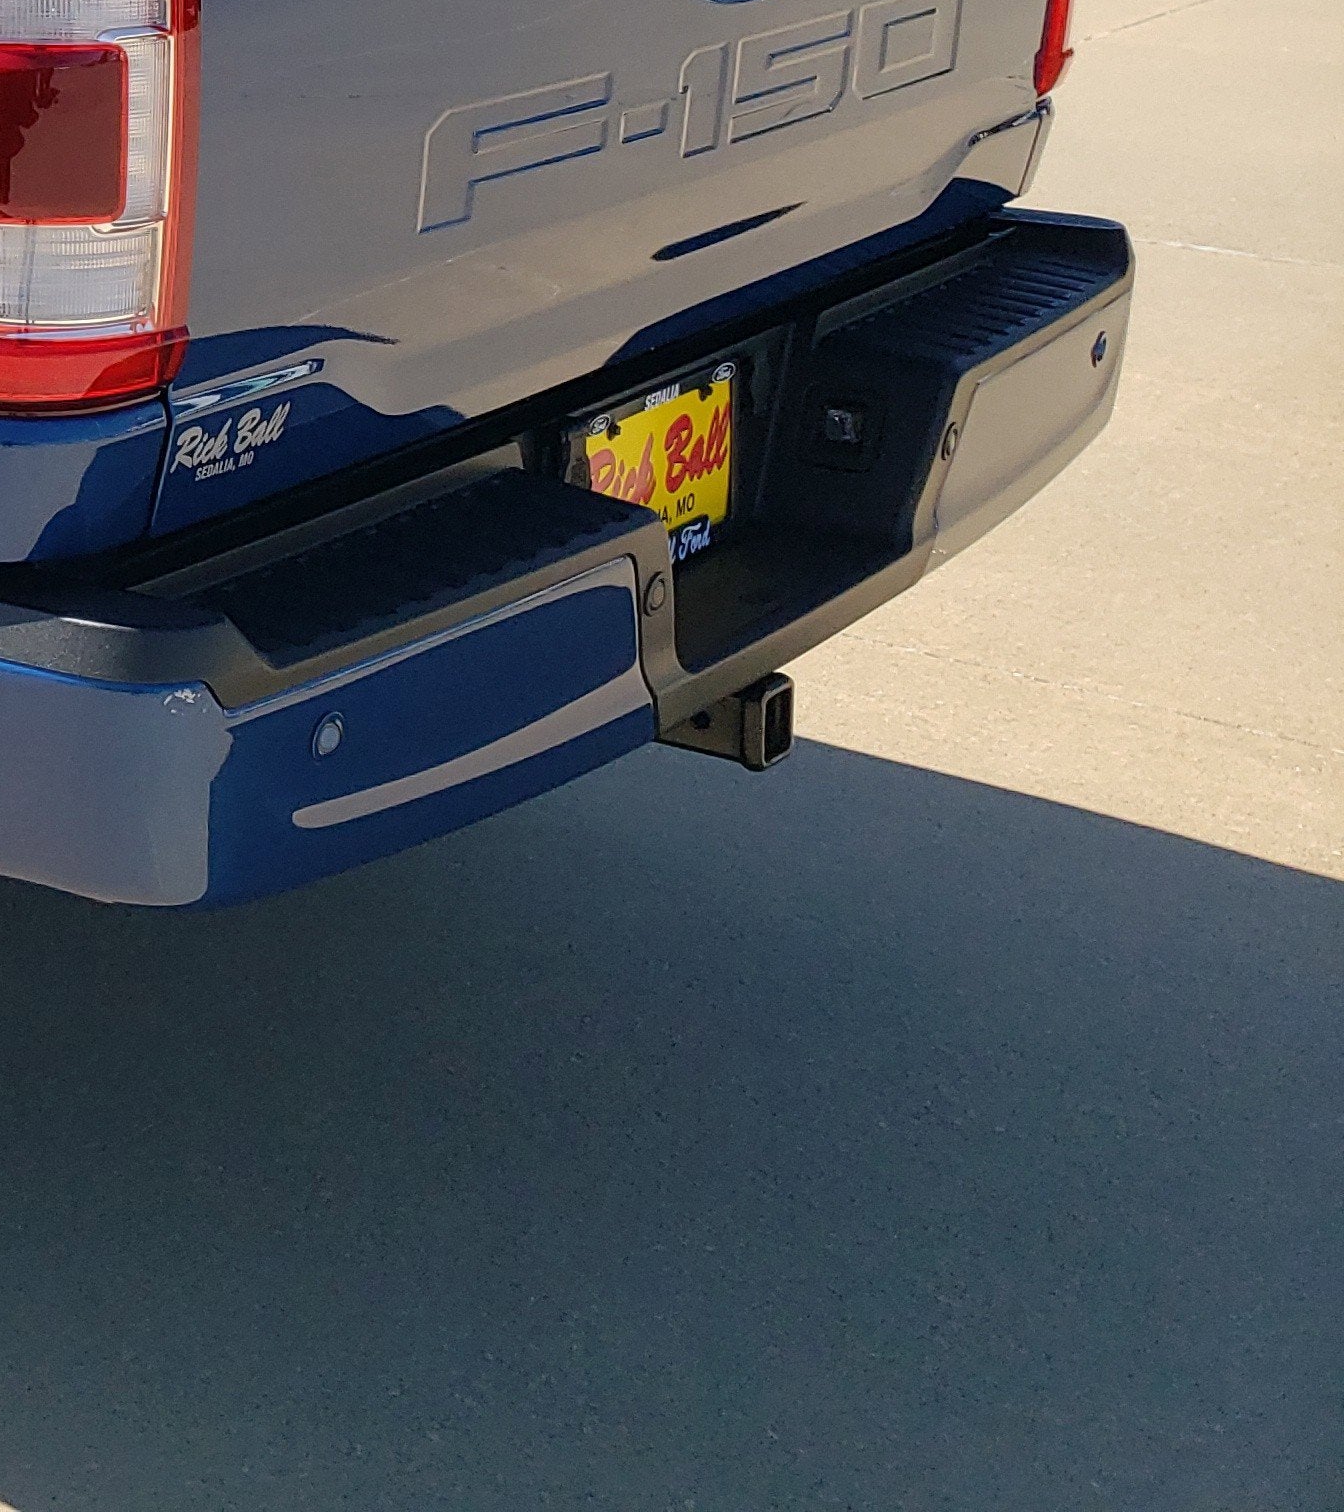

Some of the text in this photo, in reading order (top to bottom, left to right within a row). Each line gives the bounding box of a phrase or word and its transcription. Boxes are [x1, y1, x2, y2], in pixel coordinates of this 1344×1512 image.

[169, 400, 291, 474] Rick Ball
[664, 400, 731, 493] Ball
[237, 450, 254, 468] MO
[676, 492, 695, 518] MO
[678, 519, 711, 561] Ford
